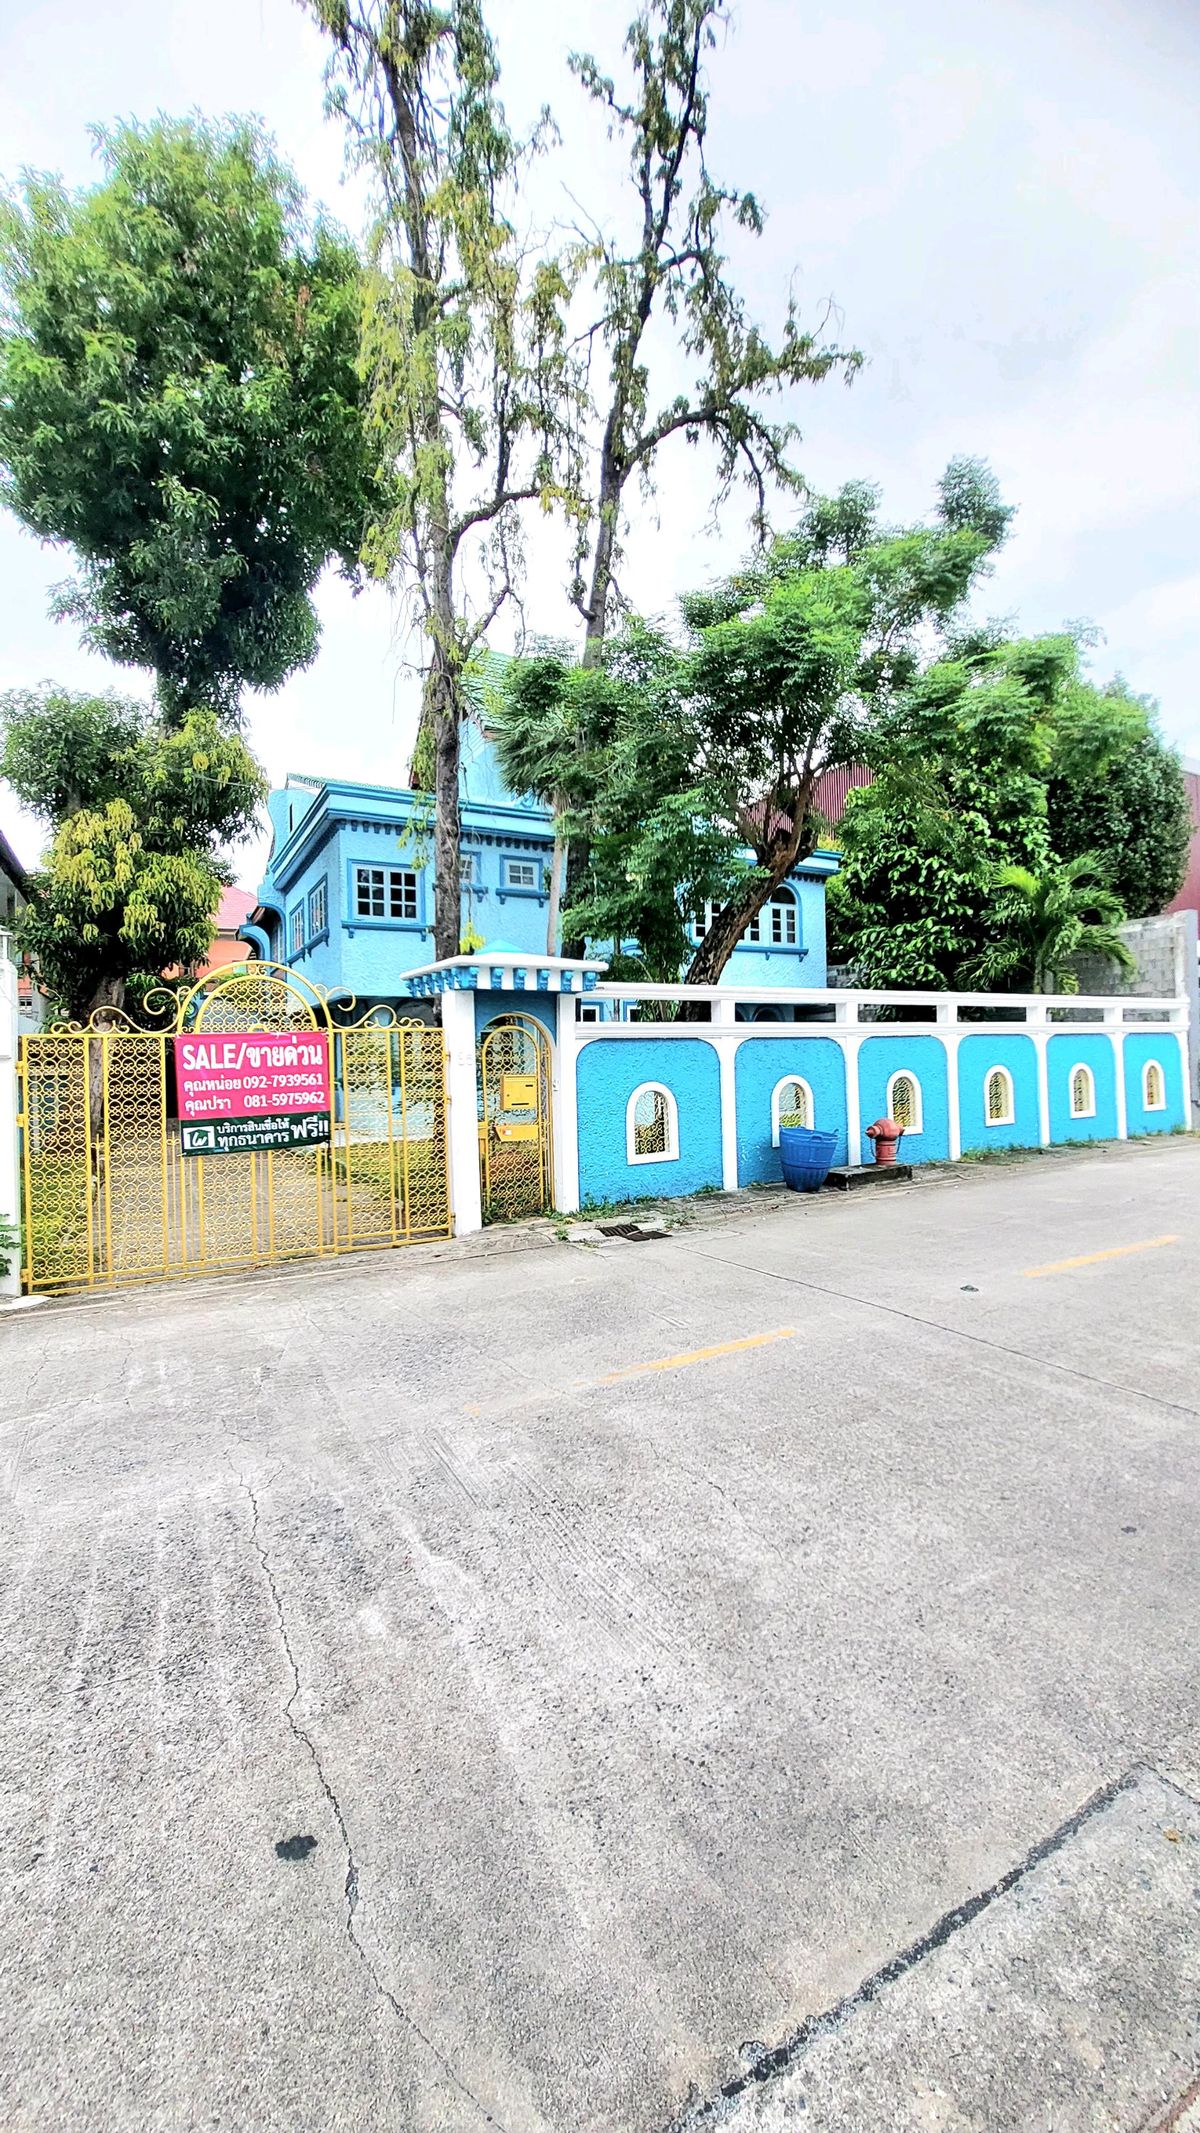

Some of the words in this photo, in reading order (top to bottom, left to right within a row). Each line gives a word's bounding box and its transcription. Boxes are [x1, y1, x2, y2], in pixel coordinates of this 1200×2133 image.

[184, 1075, 241, 1096] คุณหน่อย
[244, 1074, 323, 1089] 092-7939561
[185, 1096, 231, 1116] คุณปรา
[244, 1092, 324, 1108] 081-5975962
[217, 1117, 289, 1133] บริการสินเชื่อให้
[291, 1116, 329, 1139] ฟรี!!
[218, 1132, 289, 1151] ทุกธนาคาร
